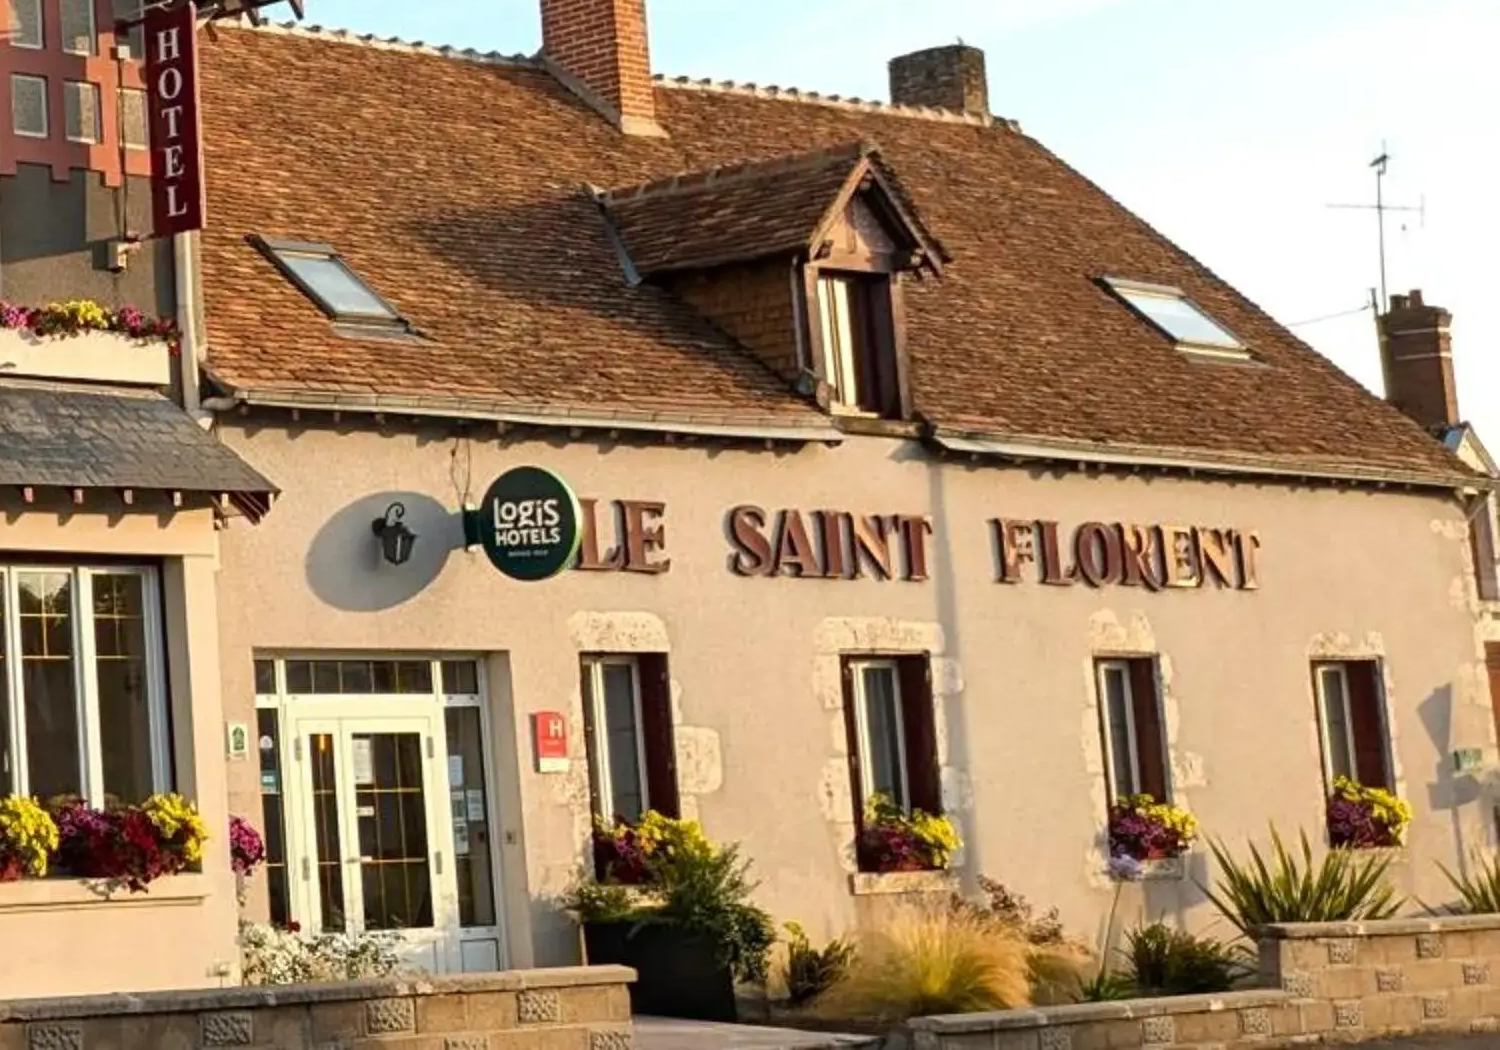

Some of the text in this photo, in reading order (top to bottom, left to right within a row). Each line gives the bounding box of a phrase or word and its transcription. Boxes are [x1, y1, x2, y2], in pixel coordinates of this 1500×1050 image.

[156, 26, 188, 218] HOTEL
[495, 527, 561, 547] HOTELS
[576, 498, 1261, 592] LE SAINT FLORENT
[548, 717, 563, 738] H
